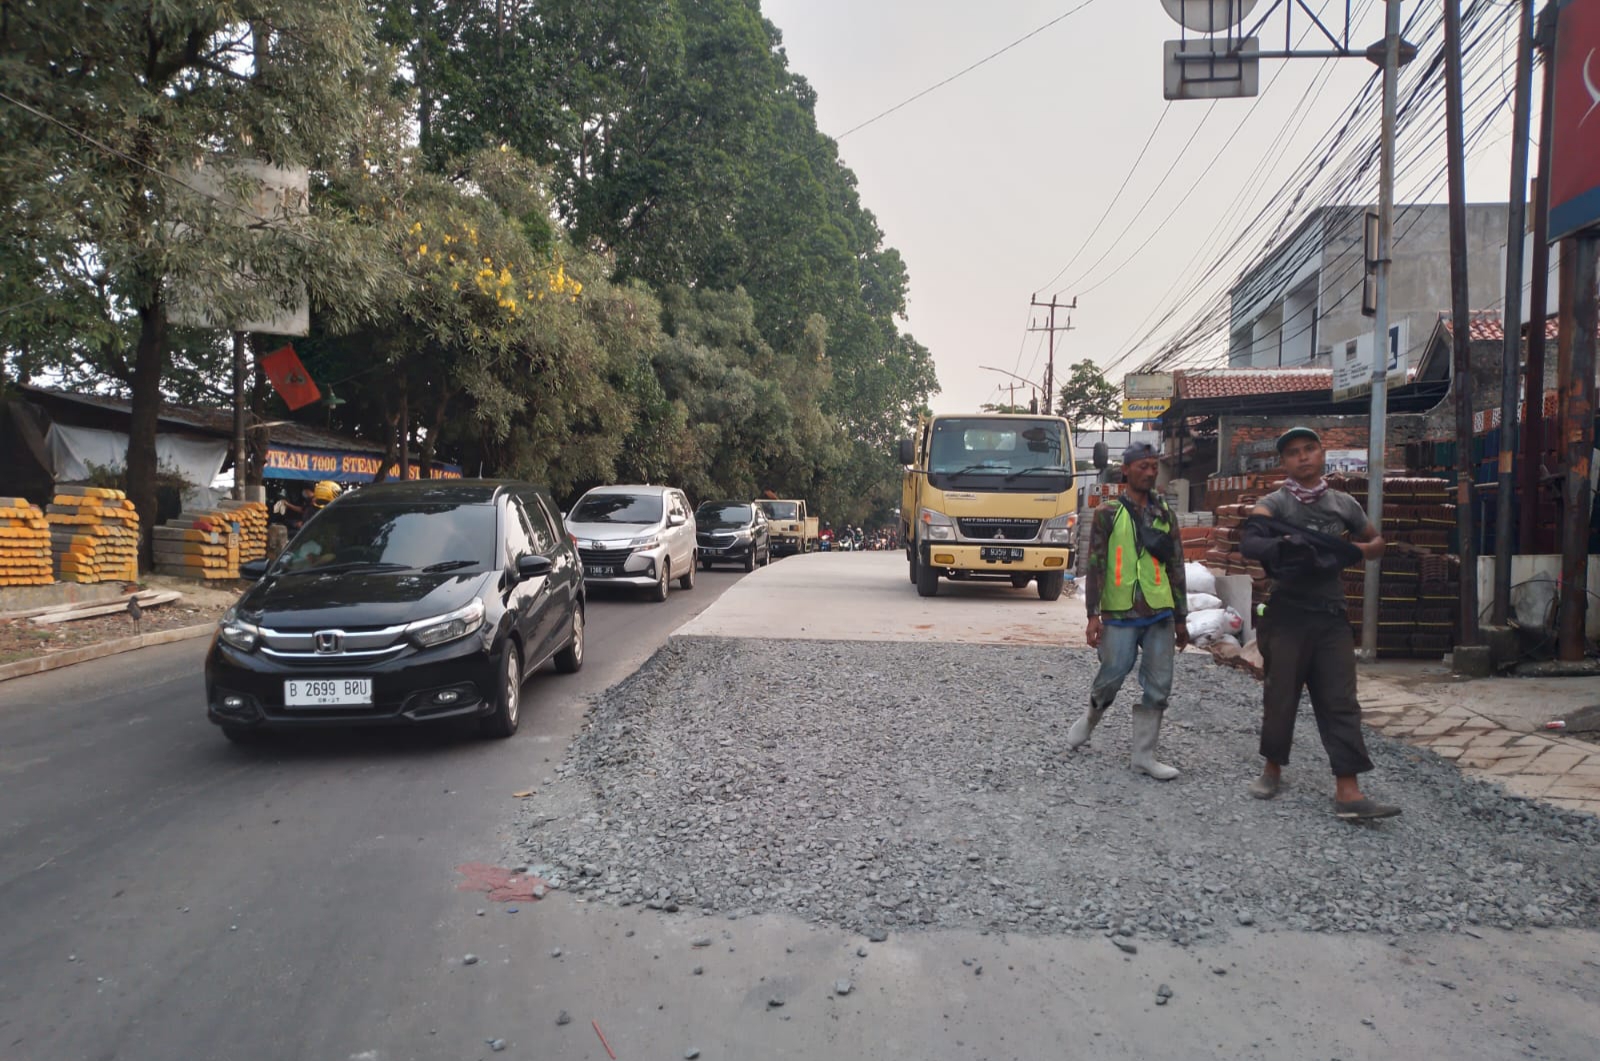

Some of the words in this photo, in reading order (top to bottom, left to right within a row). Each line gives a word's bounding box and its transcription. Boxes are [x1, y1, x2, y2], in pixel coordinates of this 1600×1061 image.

[311, 455, 337, 472] 7000
[289, 682, 298, 697] B
[305, 681, 336, 697] 2699
